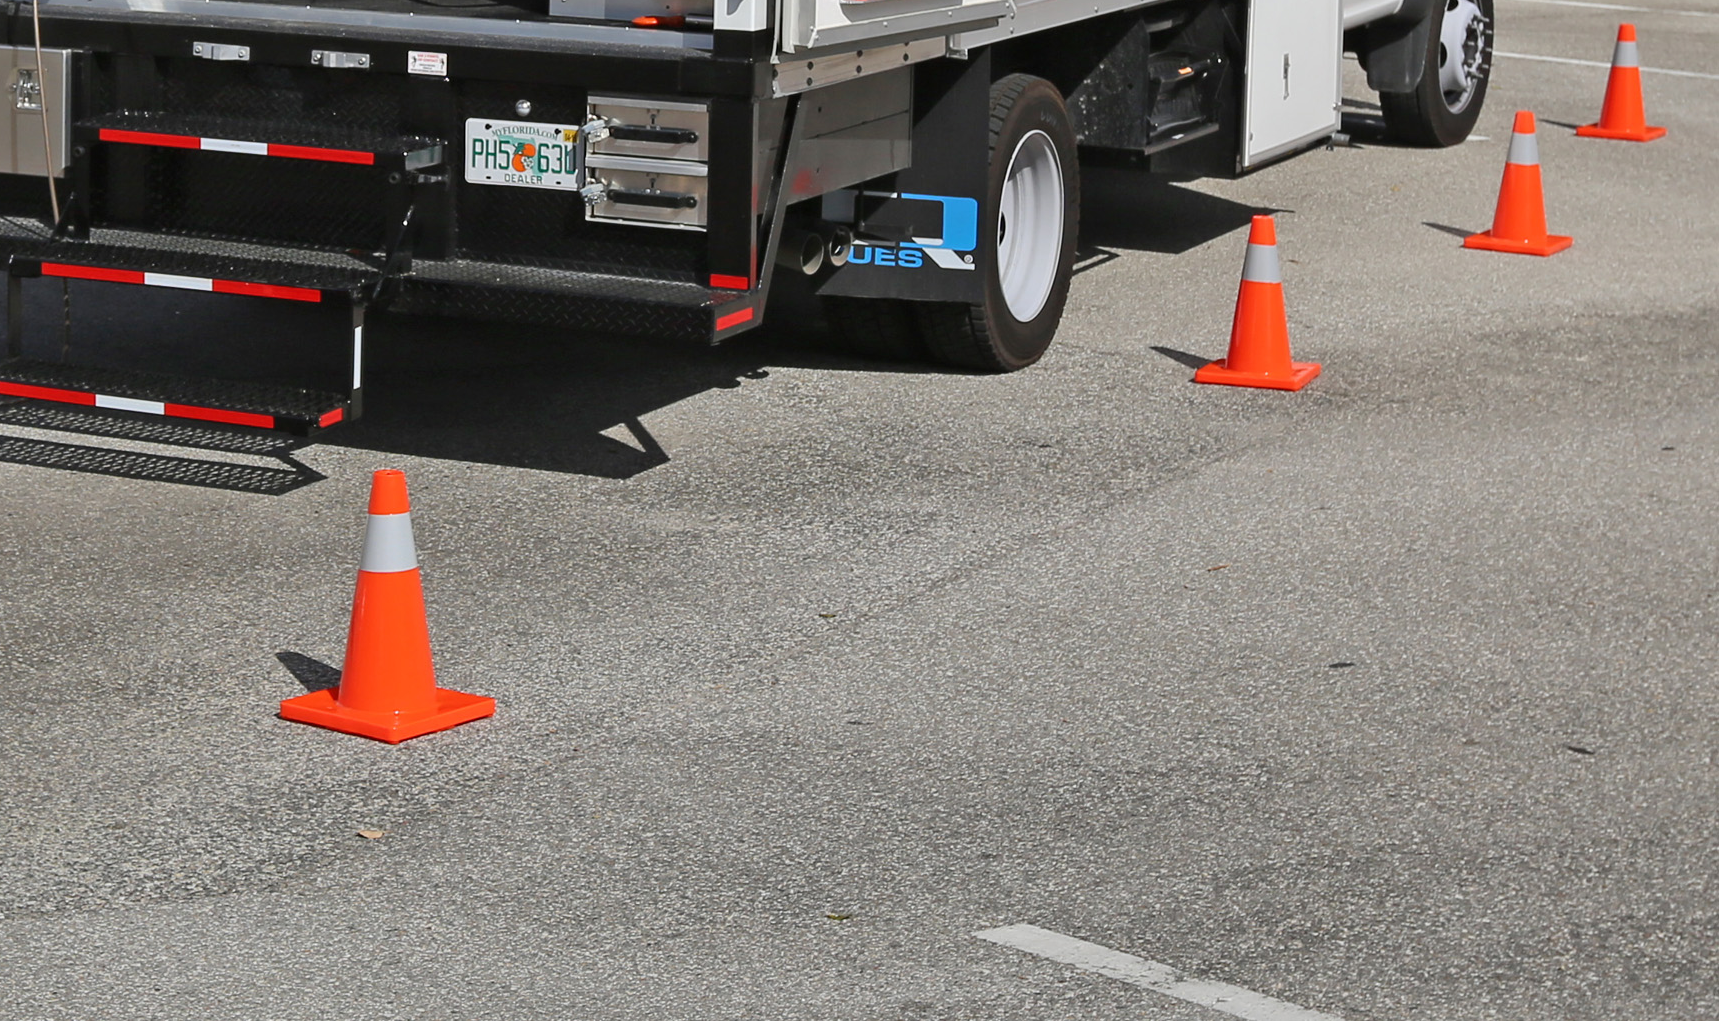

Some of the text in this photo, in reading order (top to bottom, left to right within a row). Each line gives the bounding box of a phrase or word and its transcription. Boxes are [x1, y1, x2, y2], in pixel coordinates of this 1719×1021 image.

[491, 125, 558, 141] MYFLORIDA.COM
[472, 138, 511, 170] PH5
[504, 173, 543, 185] DEALER
